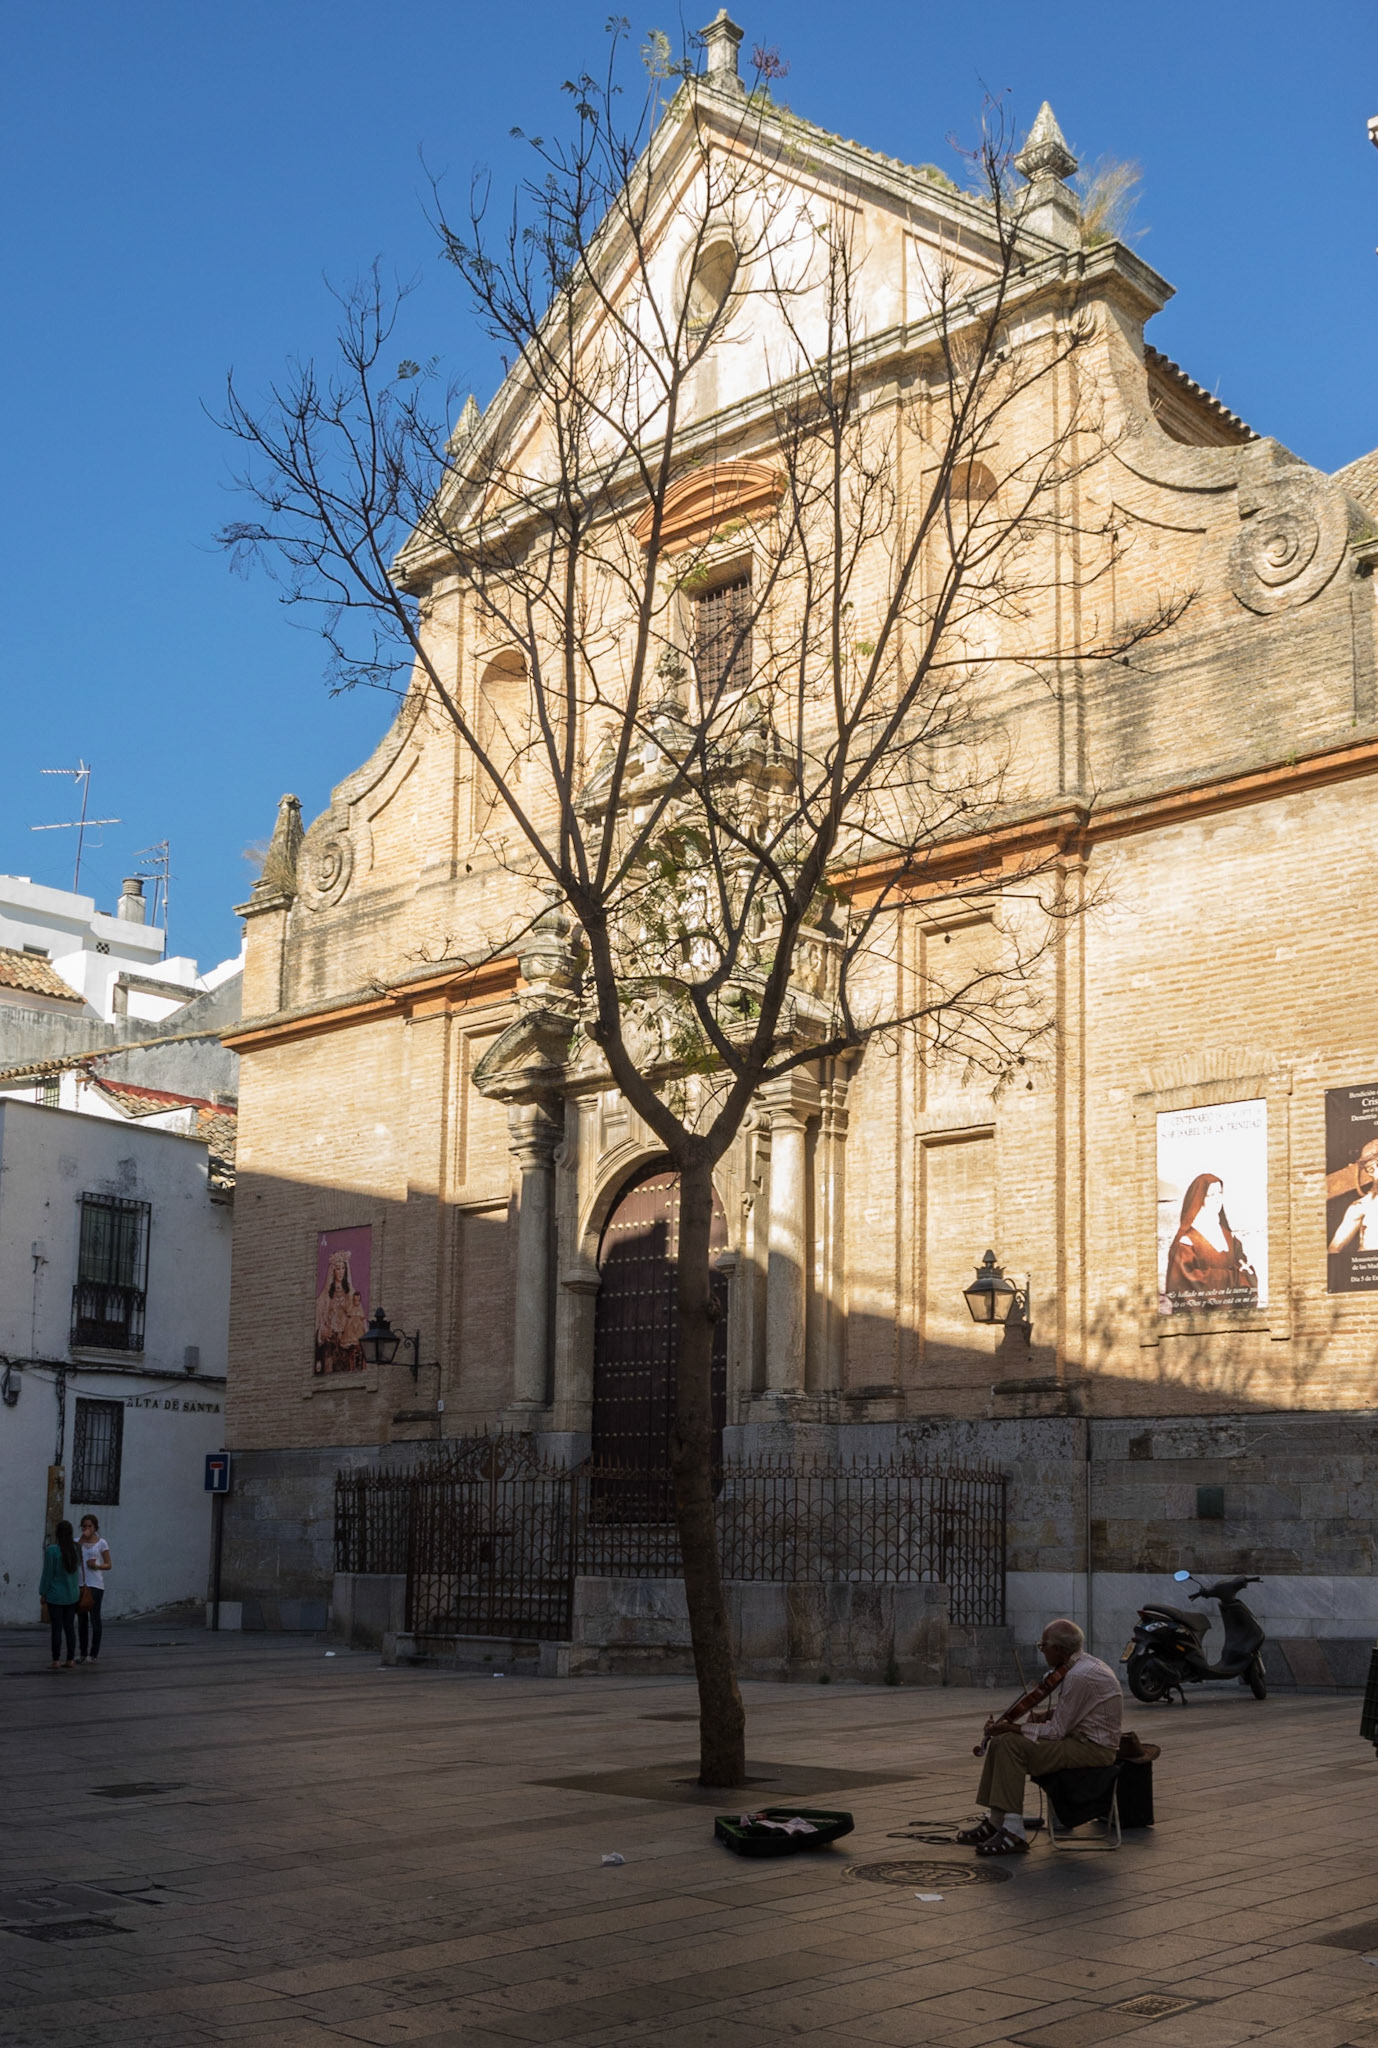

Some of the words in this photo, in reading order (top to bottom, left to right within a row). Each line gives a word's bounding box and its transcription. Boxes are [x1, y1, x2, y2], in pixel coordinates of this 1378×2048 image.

[126, 1397, 159, 1409] ALTA
[164, 1400, 180, 1411] DE
[183, 1401, 220, 1413] SANTA
